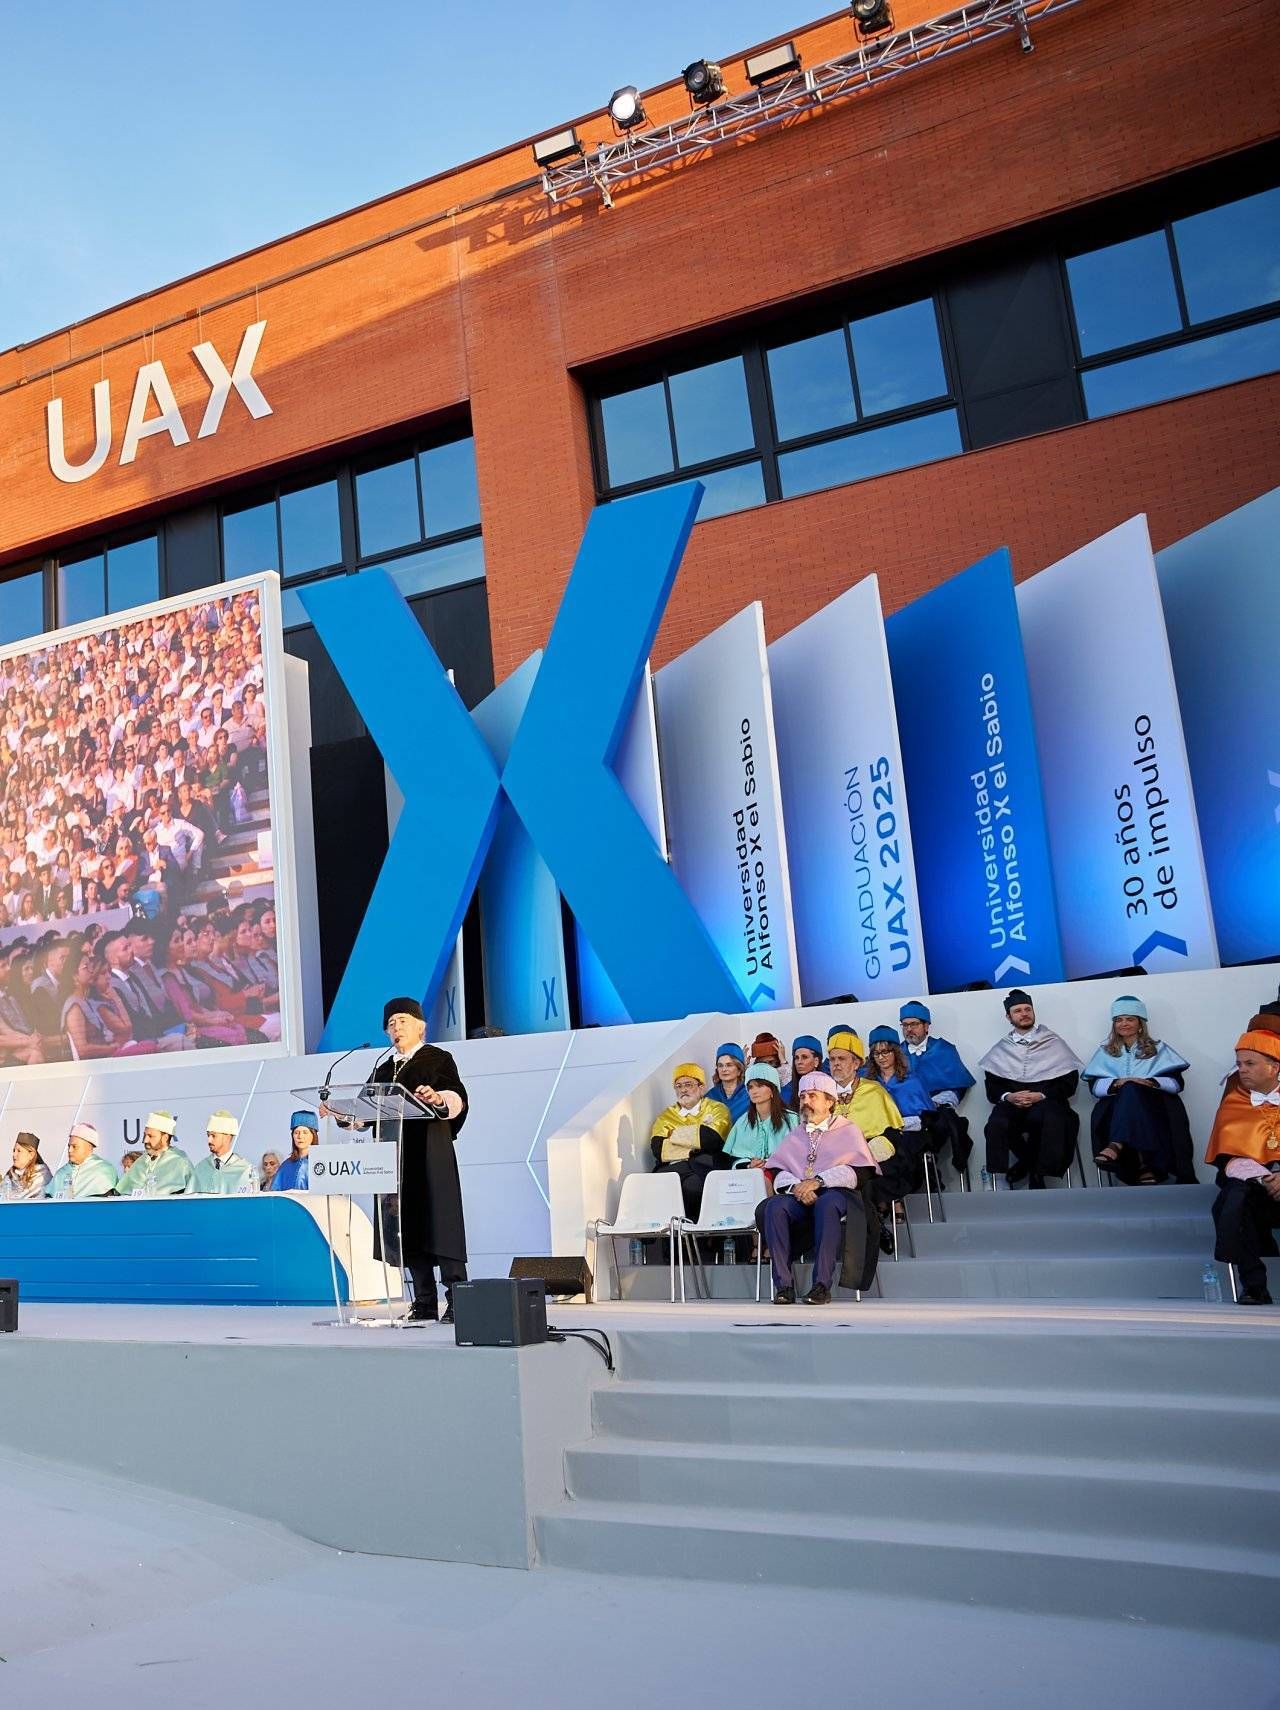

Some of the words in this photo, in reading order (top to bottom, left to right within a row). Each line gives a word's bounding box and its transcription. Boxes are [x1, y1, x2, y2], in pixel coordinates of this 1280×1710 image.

[47, 319, 274, 483] UAX
[979, 672, 1003, 757] Sabio
[740, 718, 756, 797] Sabio
[988, 761, 1008, 789] el
[1133, 714, 1170, 857] impulso
[746, 801, 759, 827] el
[749, 833, 762, 856] X
[869, 756, 900, 868] 2025
[993, 794, 1012, 821] X
[1114, 783, 1141, 866] años
[732, 808, 759, 976] Universidad
[843, 765, 881, 980] GRADUACIÓN
[970, 770, 1007, 949] Universidad
[1000, 824, 1027, 941] Alfonso
[1122, 876, 1148, 919] 30
[1153, 865, 1178, 910] de
[754, 860, 773, 970] Alfonso
[882, 874, 912, 972] UAX
[328, 1160, 361, 1176] UAX
